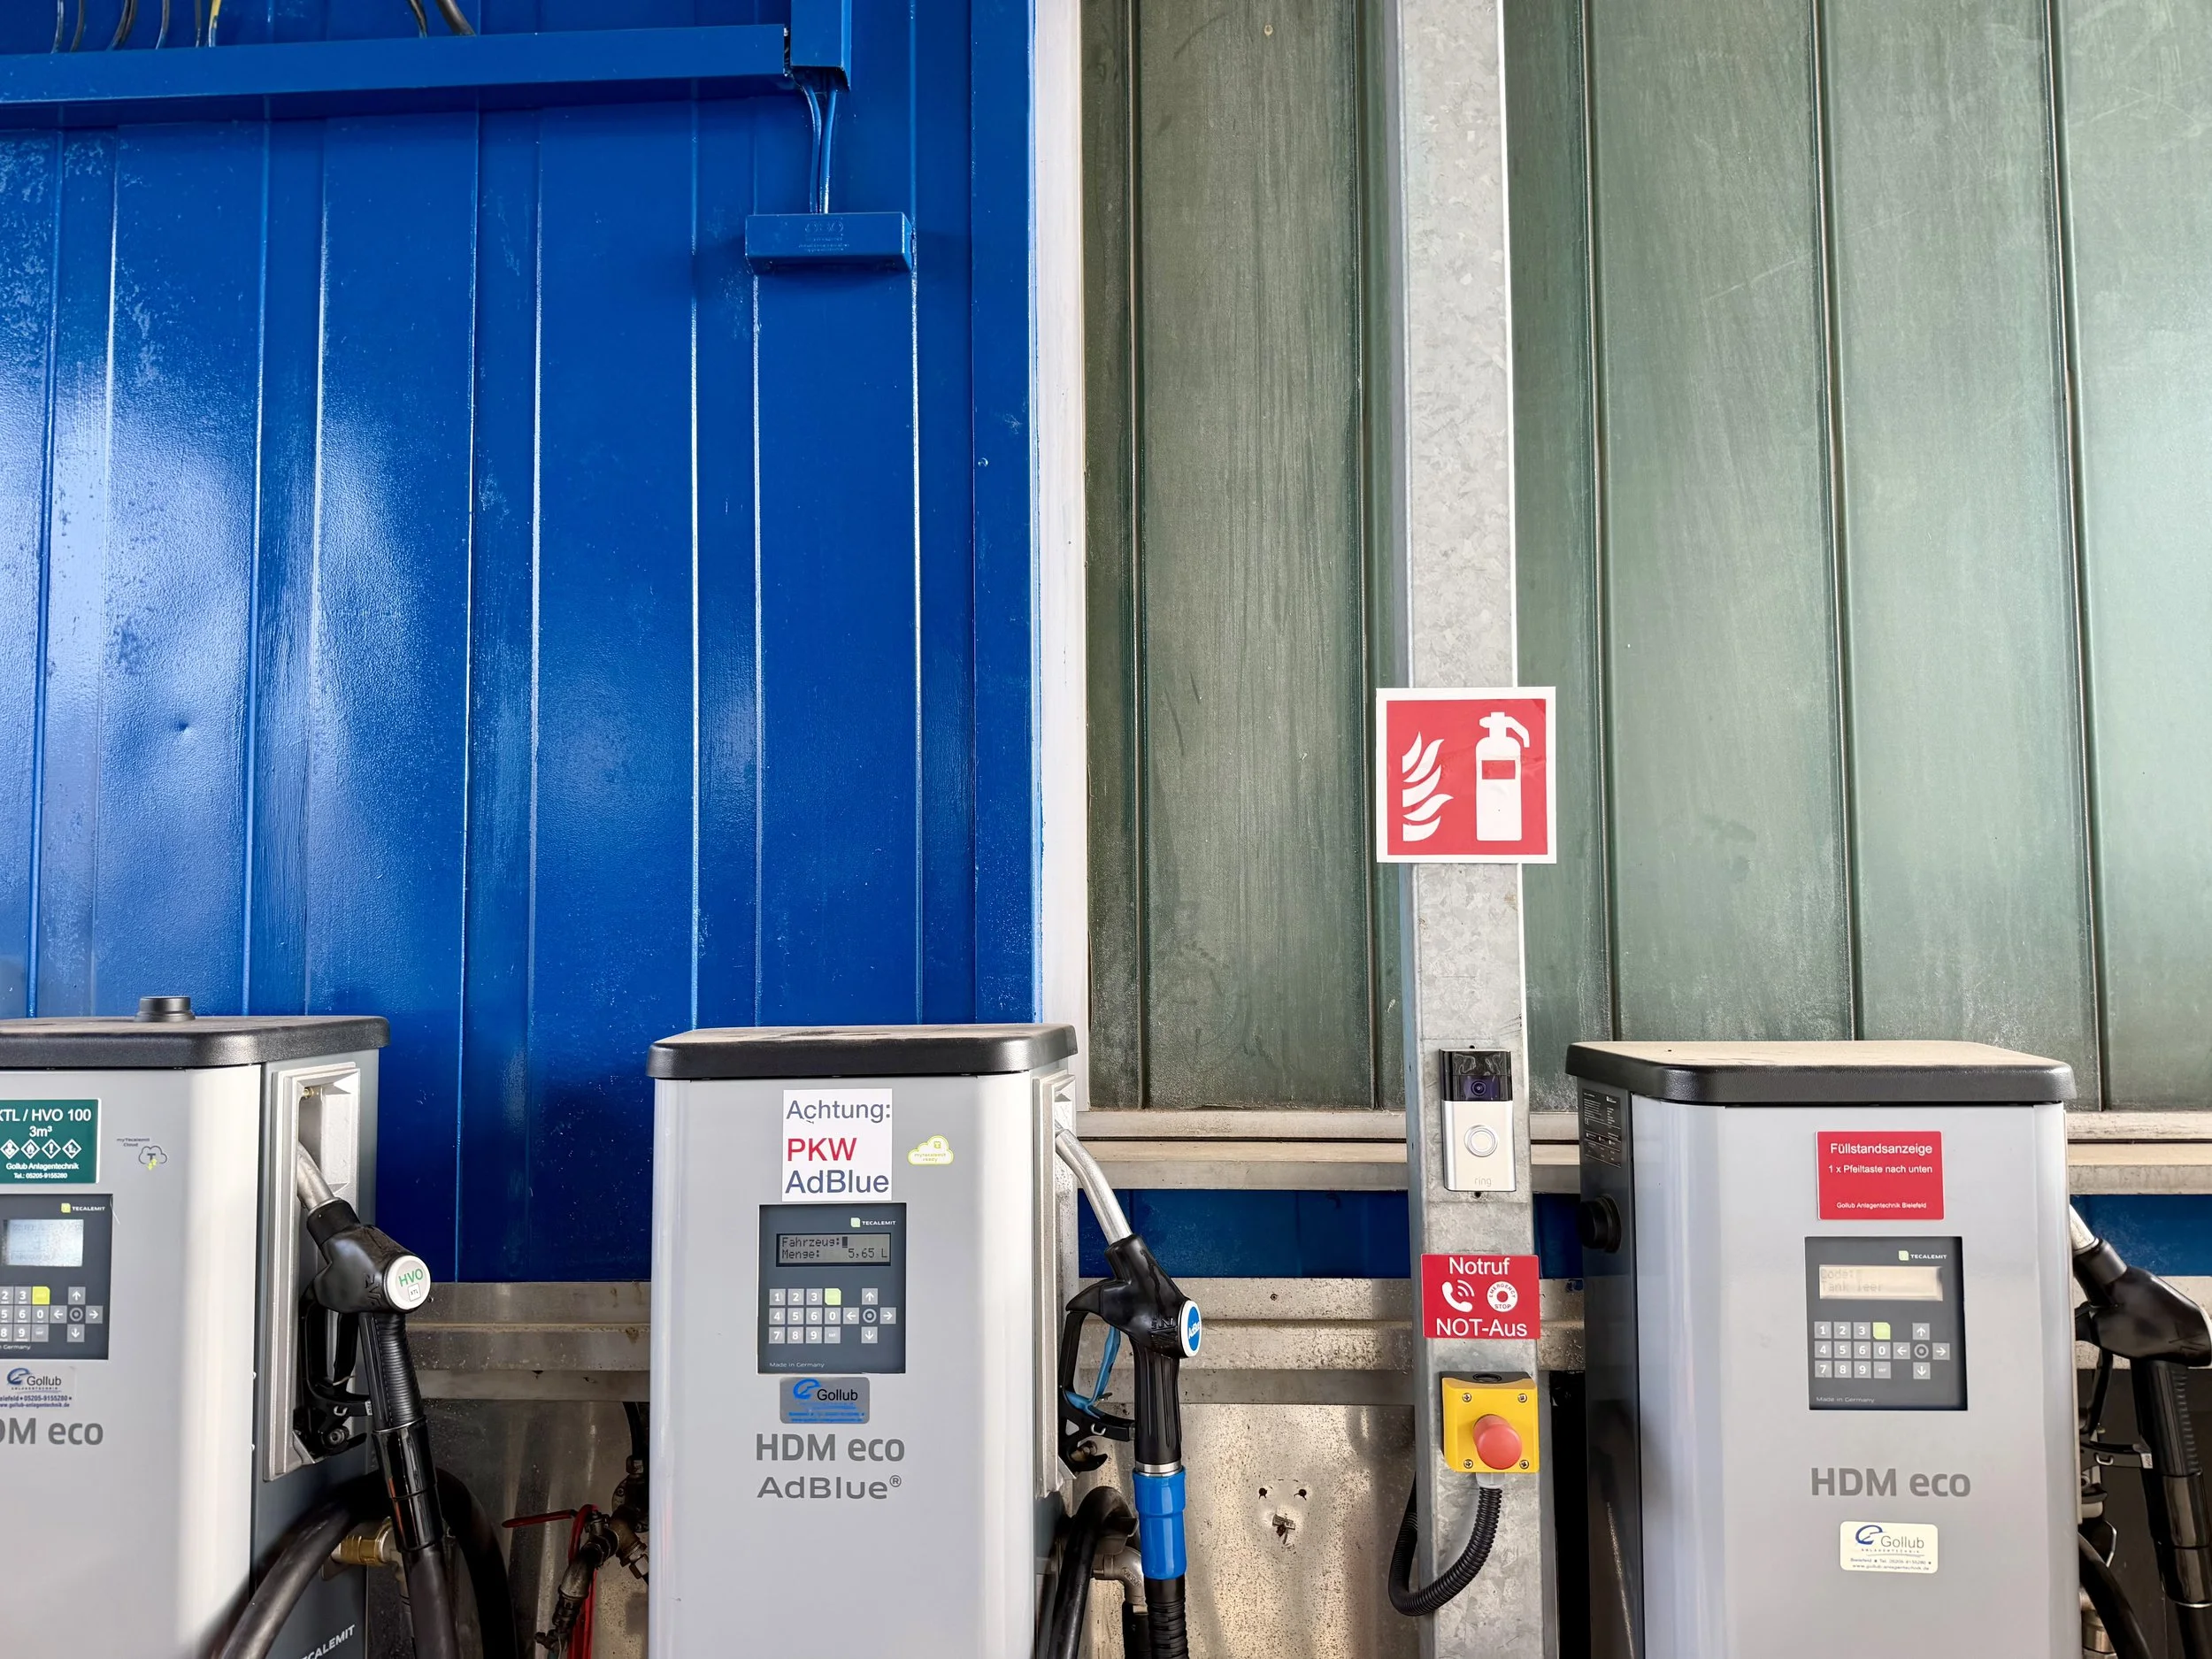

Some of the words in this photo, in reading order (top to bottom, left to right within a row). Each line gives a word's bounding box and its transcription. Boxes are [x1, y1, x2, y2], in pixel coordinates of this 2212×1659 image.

[32, 1109, 63, 1122] HVO
[67, 1109, 92, 1122] 100
[786, 1100, 891, 1124] Achtung:
[787, 1137, 857, 1162] PKW
[1830, 1142, 1932, 1156] Füllstandsanzeige
[28, 1163, 79, 1171] Anlagentechnik
[1843, 1164, 1883, 1173] Pfeiltaste
[1885, 1164, 1907, 1173] nach
[785, 1169, 889, 1194] AdBlue
[1474, 1176, 1492, 1187] ring
[1856, 1202, 1901, 1210] Anlagentechnik
[781, 1249, 820, 1259] Menge:
[848, 1248, 875, 1259] 5,65
[881, 1248, 888, 1258] L
[1448, 1257, 1509, 1276] Notruf
[398, 1268, 424, 1287] HVO
[1, 1291, 9, 1301] 2
[19, 1291, 27, 1301] 3
[1488, 1283, 1517, 1298] EMERGENCY
[774, 1293, 780, 1302] 1
[793, 1293, 799, 1302] 2
[811, 1293, 818, 1302] 3
[1, 1310, 8, 1319] 5
[19, 1310, 26, 1319] 6
[36, 1310, 44, 1319] 0
[773, 1311, 780, 1320] 4
[793, 1311, 799, 1320] 5
[811, 1311, 818, 1320] 6
[829, 1311, 836, 1320] 0
[1436, 1318, 1527, 1336] NOT-Aus
[1859, 1326, 1865, 1335] 3
[0, 1328, 8, 1338] 8
[18, 1328, 26, 1338] 9
[773, 1331, 780, 1340] 7
[792, 1331, 799, 1340] 8
[810, 1331, 818, 1340] 9
[1839, 1346, 1846, 1355] 5
[1878, 1347, 1886, 1356] 0
[1819, 1365, 1826, 1374] 7
[1839, 1365, 1846, 1374] 8
[1859, 1366, 1866, 1375] 9
[27, 1376, 62, 1386] Gollub
[817, 1389, 858, 1401] Gollub
[48, 1421, 104, 1445] eco
[757, 1433, 836, 1461] HDM
[848, 1439, 905, 1462] eco
[1811, 1468, 1897, 1496] HDM
[1909, 1473, 1970, 1497] eco
[1880, 1535, 1924, 1548] Gollub
[302, 1624, 355, 1659] CALEMIT
